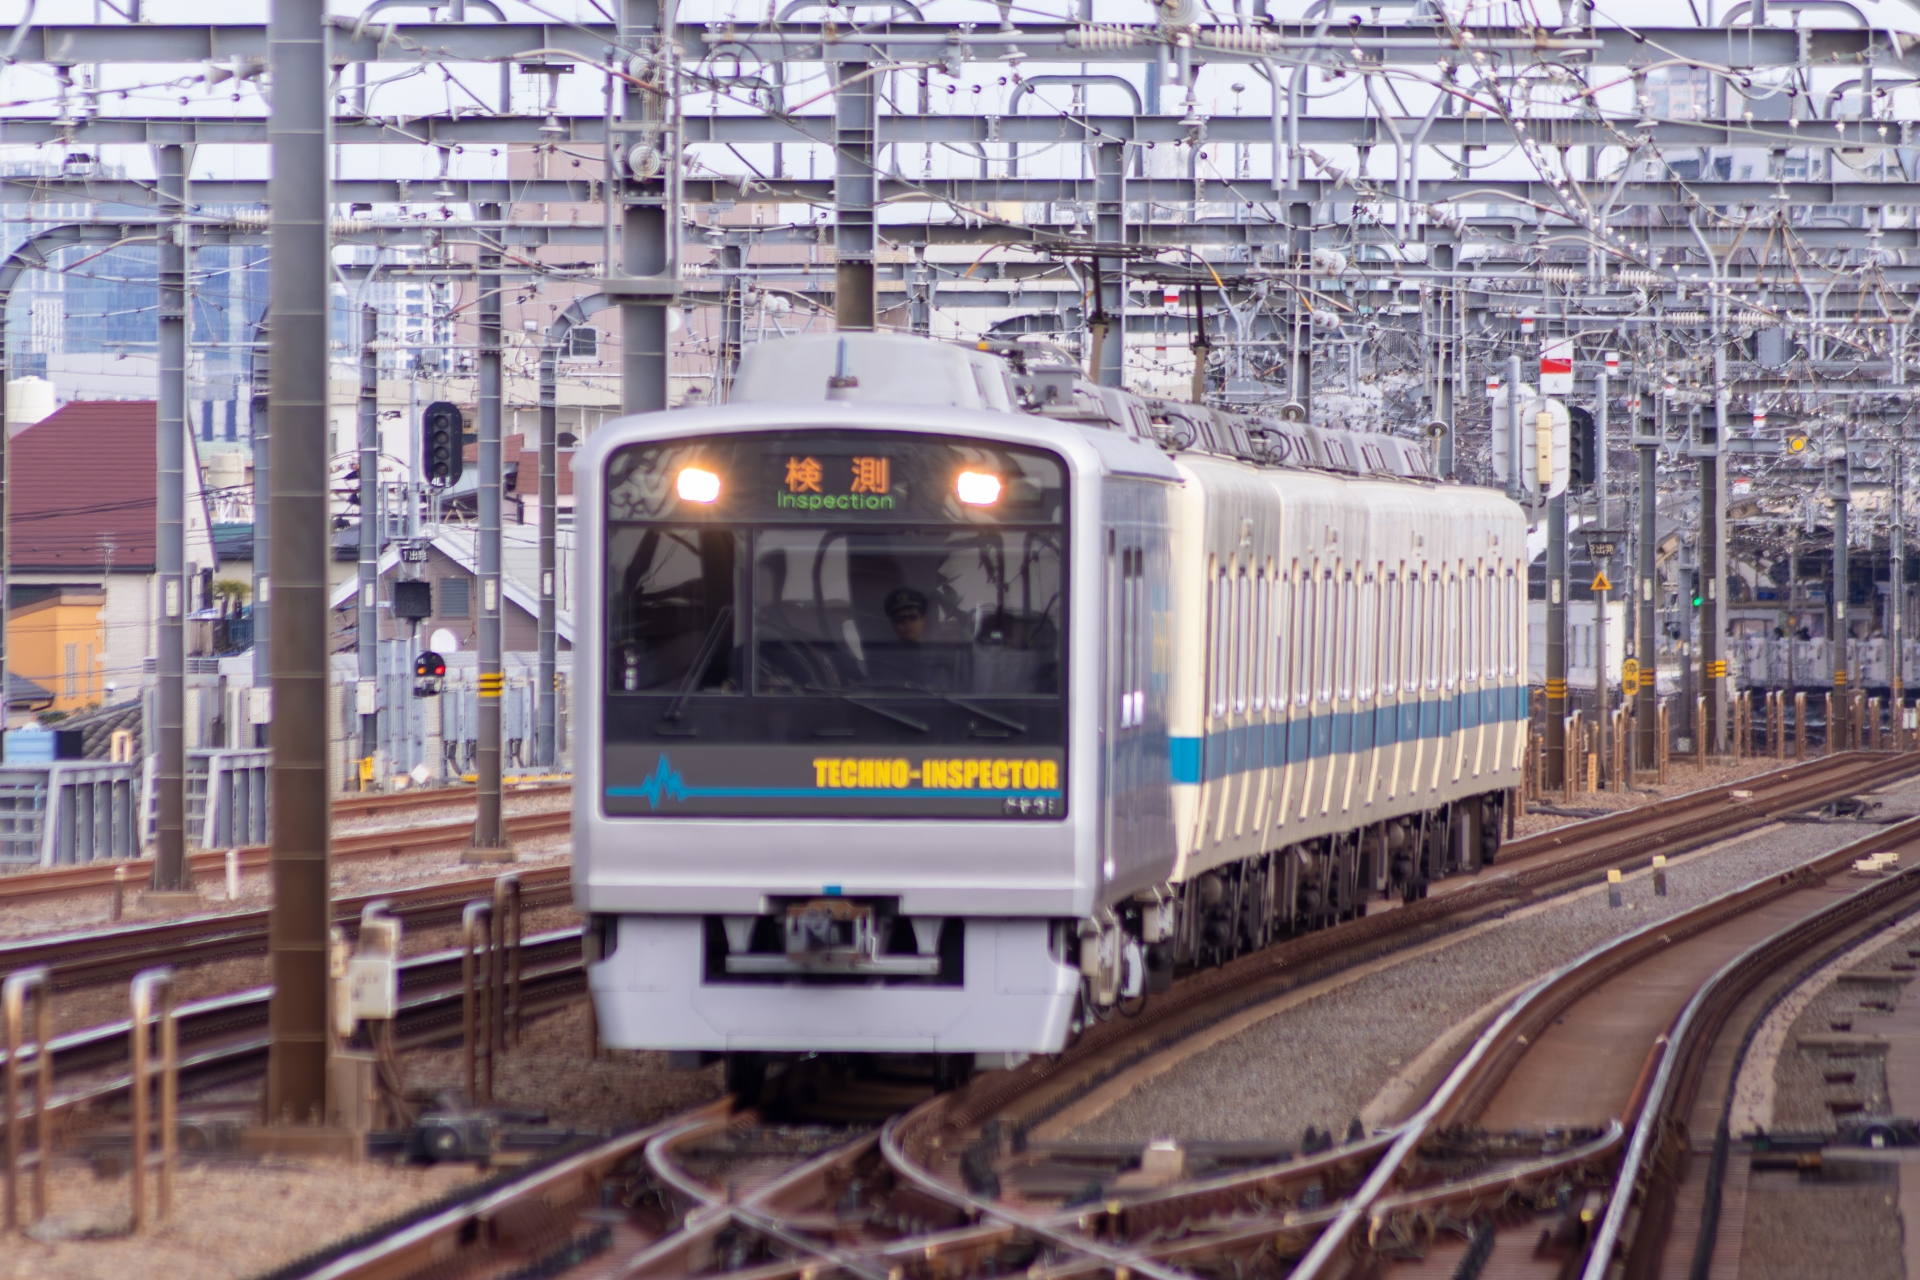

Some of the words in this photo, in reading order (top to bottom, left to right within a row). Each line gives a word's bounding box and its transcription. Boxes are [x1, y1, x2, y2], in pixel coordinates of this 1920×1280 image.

[784, 456, 891, 493] 検測
[777, 490, 895, 510] Inspection
[813, 758, 1058, 789] TECHNO-INSPECTOR
